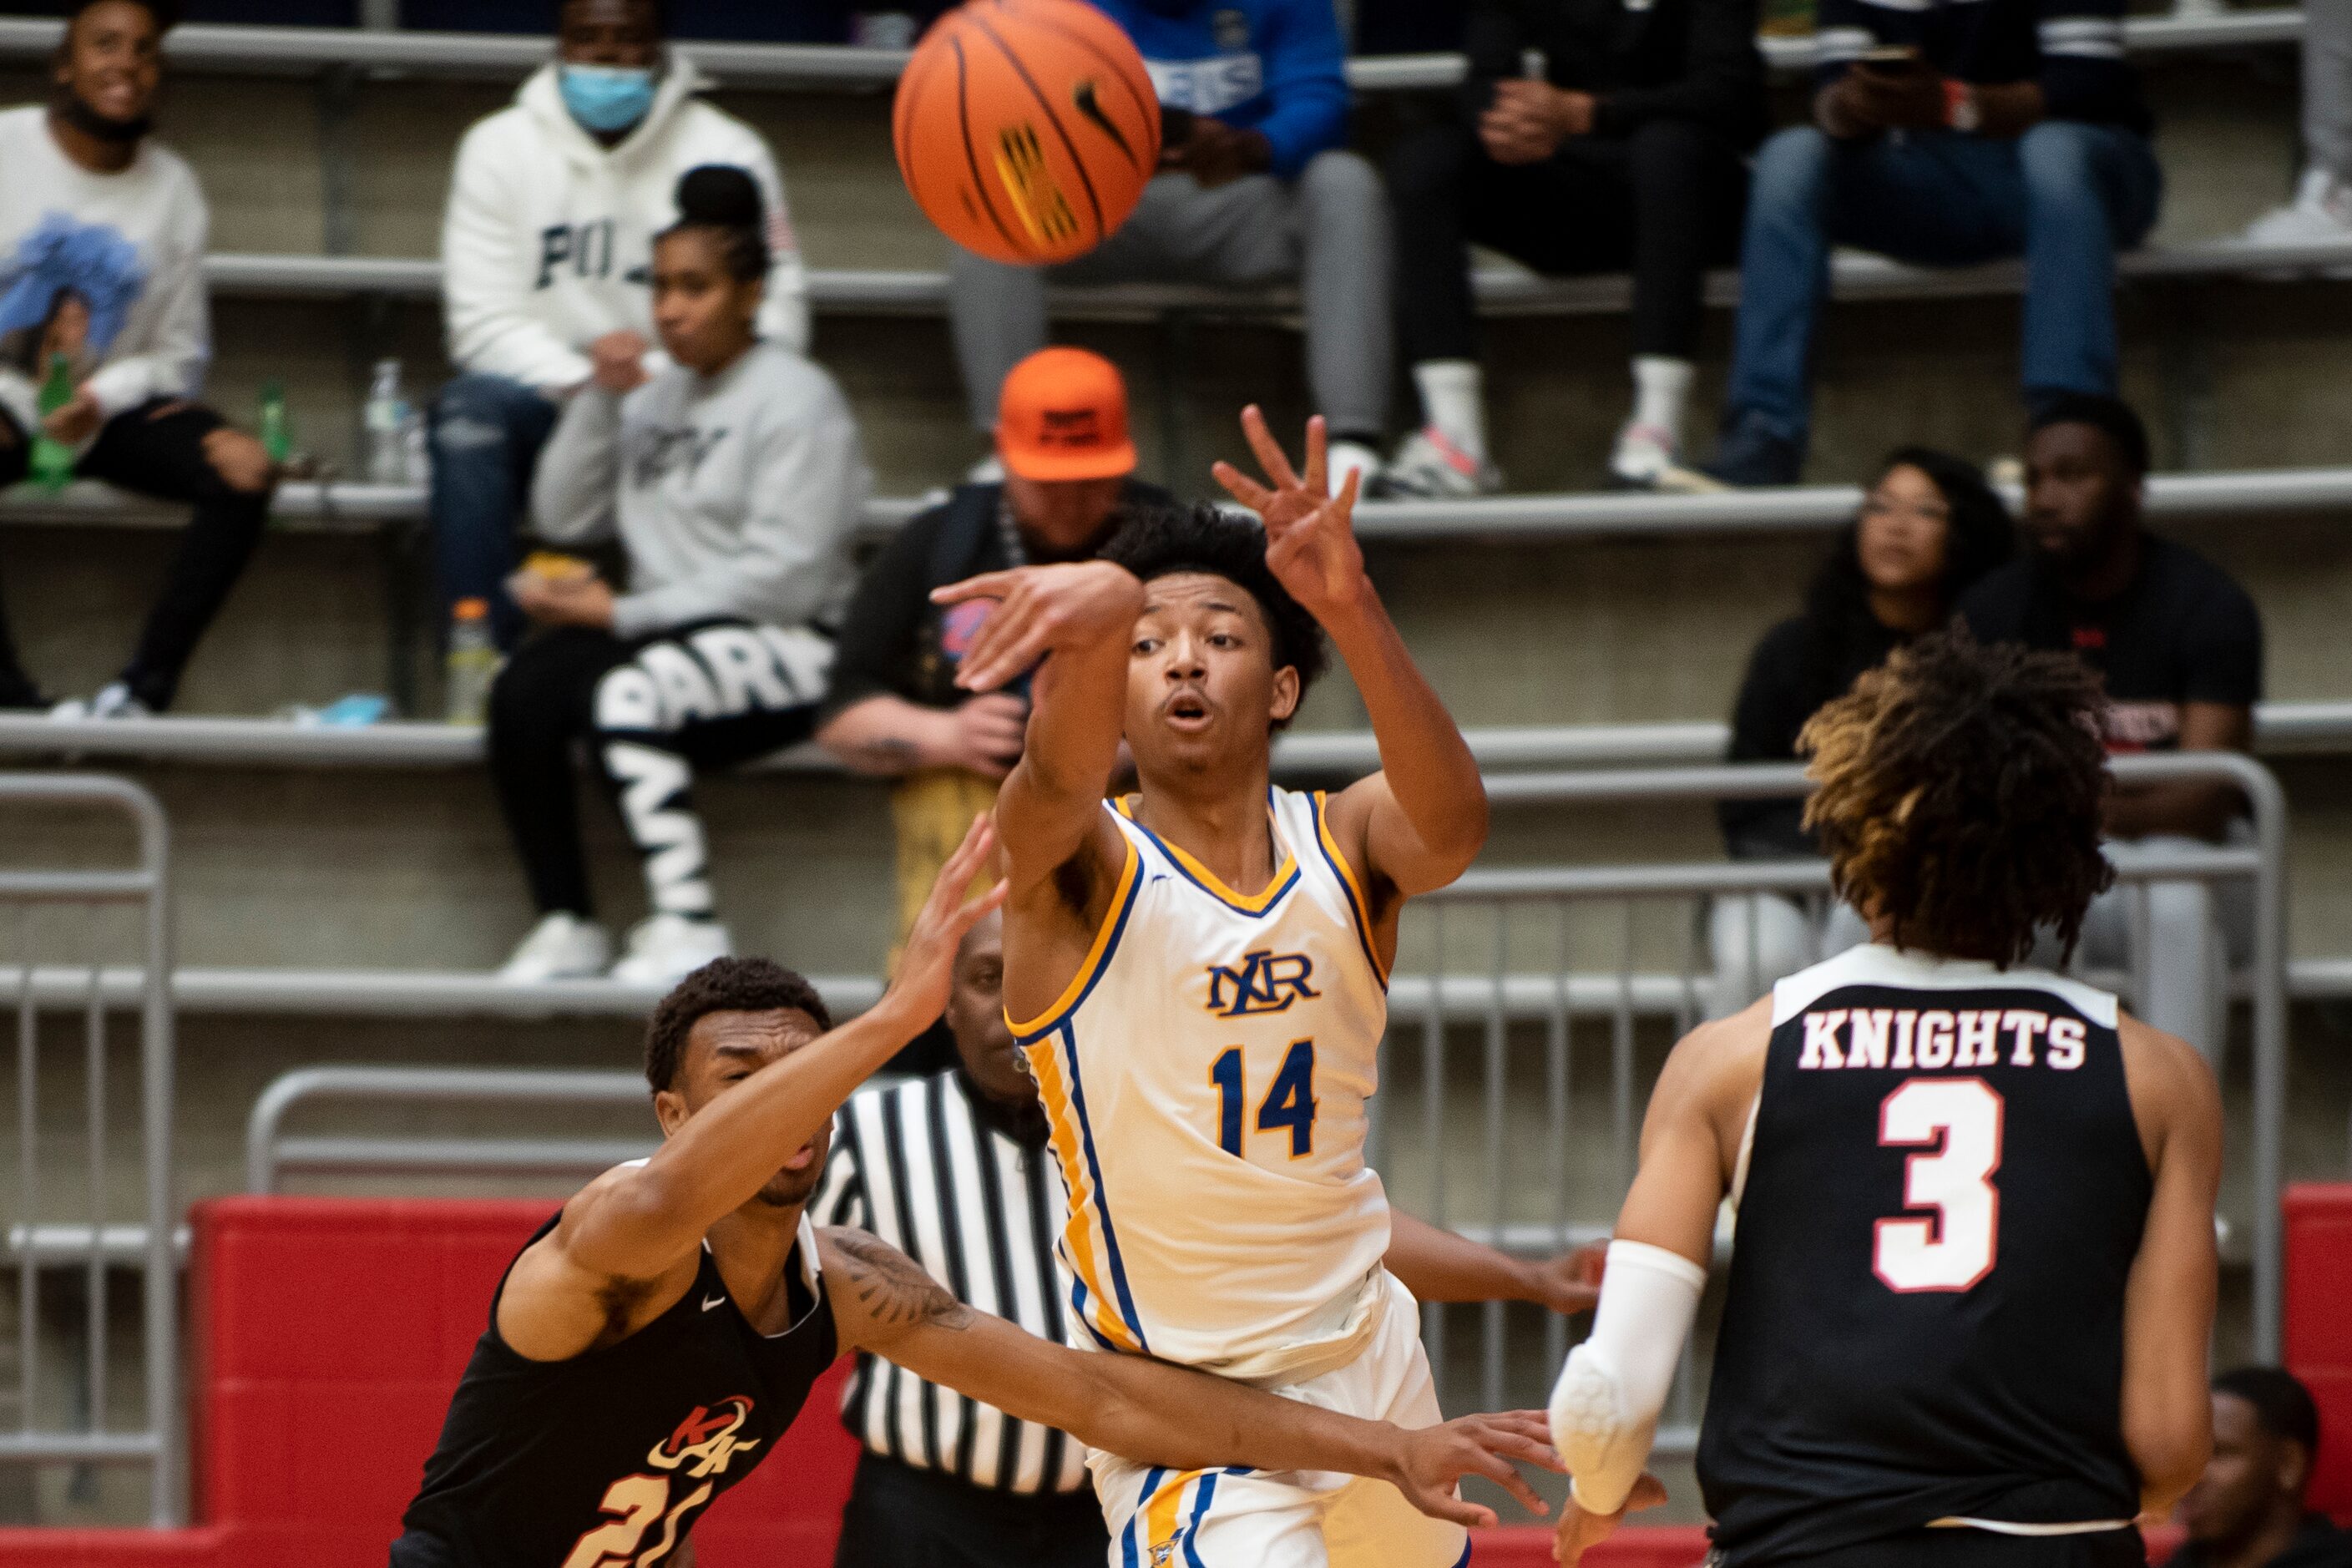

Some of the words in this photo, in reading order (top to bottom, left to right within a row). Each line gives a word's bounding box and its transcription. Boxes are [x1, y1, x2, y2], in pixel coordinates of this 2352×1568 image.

[1208, 1036, 1319, 1161] 14
[1798, 1008, 2088, 1070] KNIGHTS
[1872, 1075, 2005, 1293] 3
